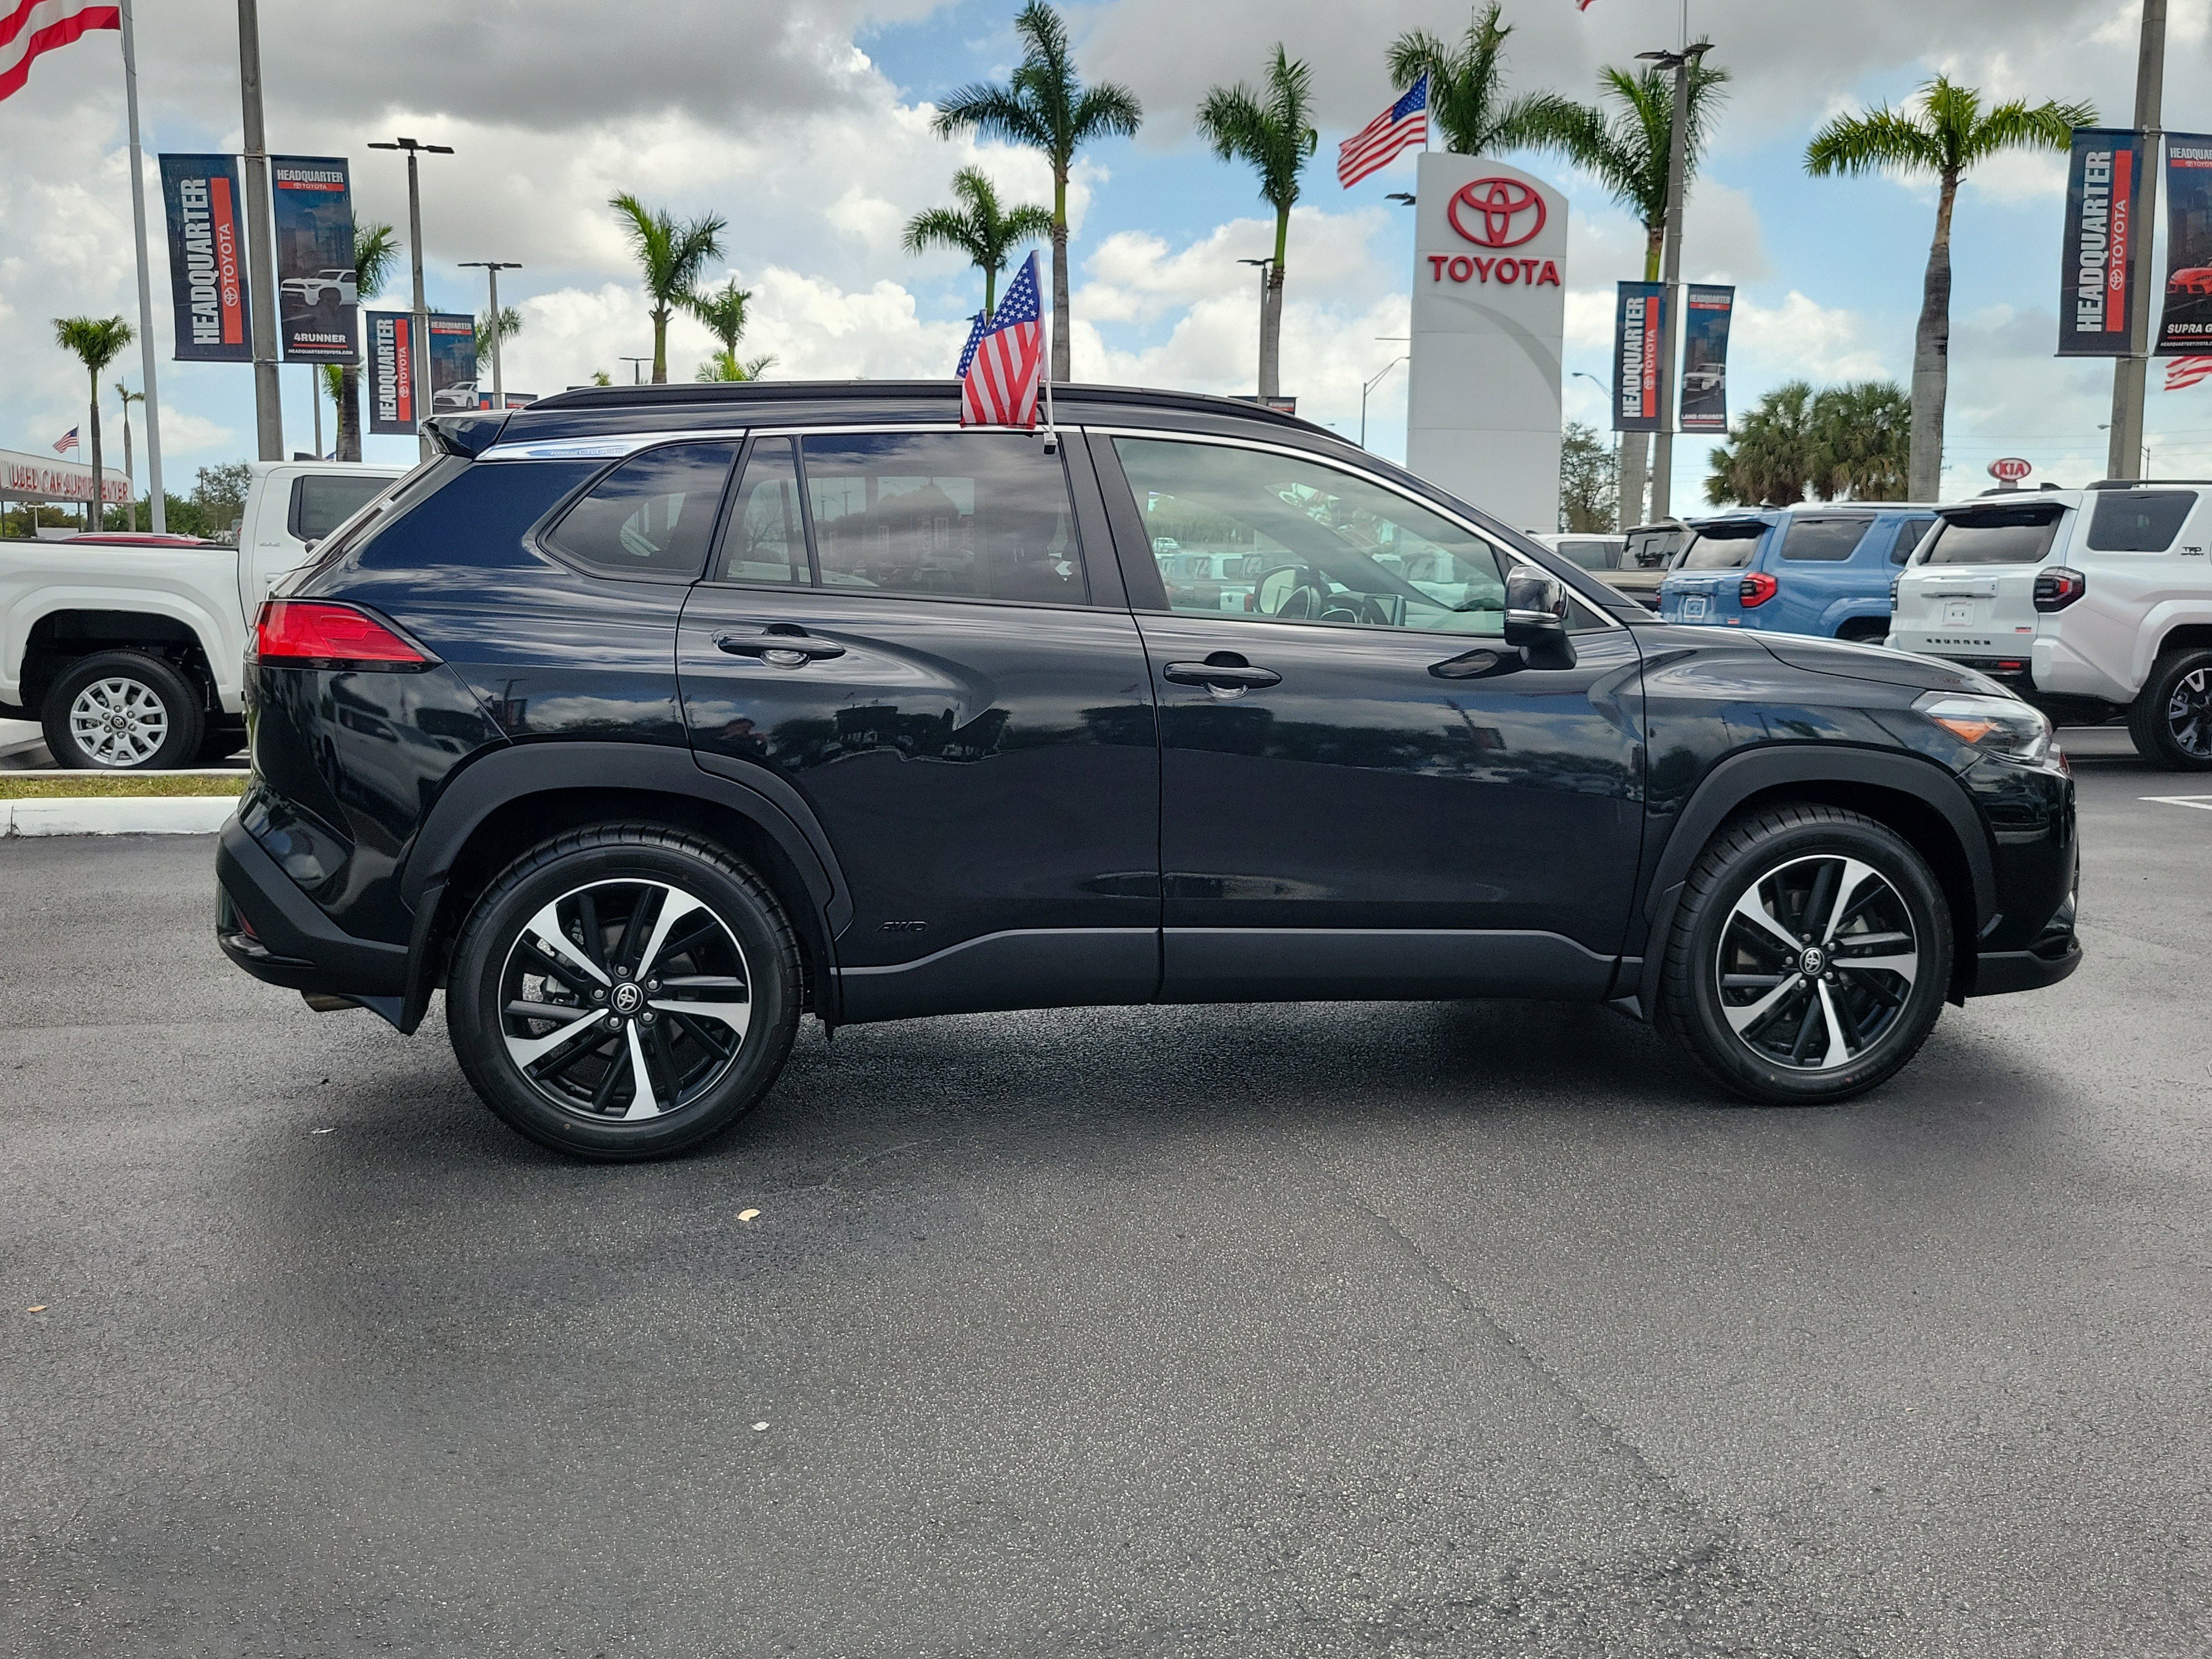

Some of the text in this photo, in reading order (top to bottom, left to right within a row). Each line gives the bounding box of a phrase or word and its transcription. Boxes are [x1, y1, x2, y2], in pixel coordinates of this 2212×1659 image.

[277, 169, 344, 183] HEADQUARTER
[2076, 151, 2111, 332] HEADQUARTER
[2112, 200, 2126, 268] TOYOTA
[180, 179, 220, 345] HEADQUARTER
[218, 223, 239, 286] TOYOTA
[1428, 256, 1560, 286] TOYOTA
[294, 332, 346, 343] 4RUNNER
[431, 321, 472, 330] HEADQUARTER
[2167, 323, 2202, 334] SUPRA
[377, 319, 397, 421] HEADQUARTER
[399, 347, 408, 385] TOYOTA
[1622, 297, 1645, 417] HEADQUARTER
[1645, 330, 1656, 374] TOYOTA
[12, 464, 38, 490] USED
[42, 469, 62, 493] CAR
[101, 479, 128, 501] ENTER
[1999, 462, 2025, 476] KIA
